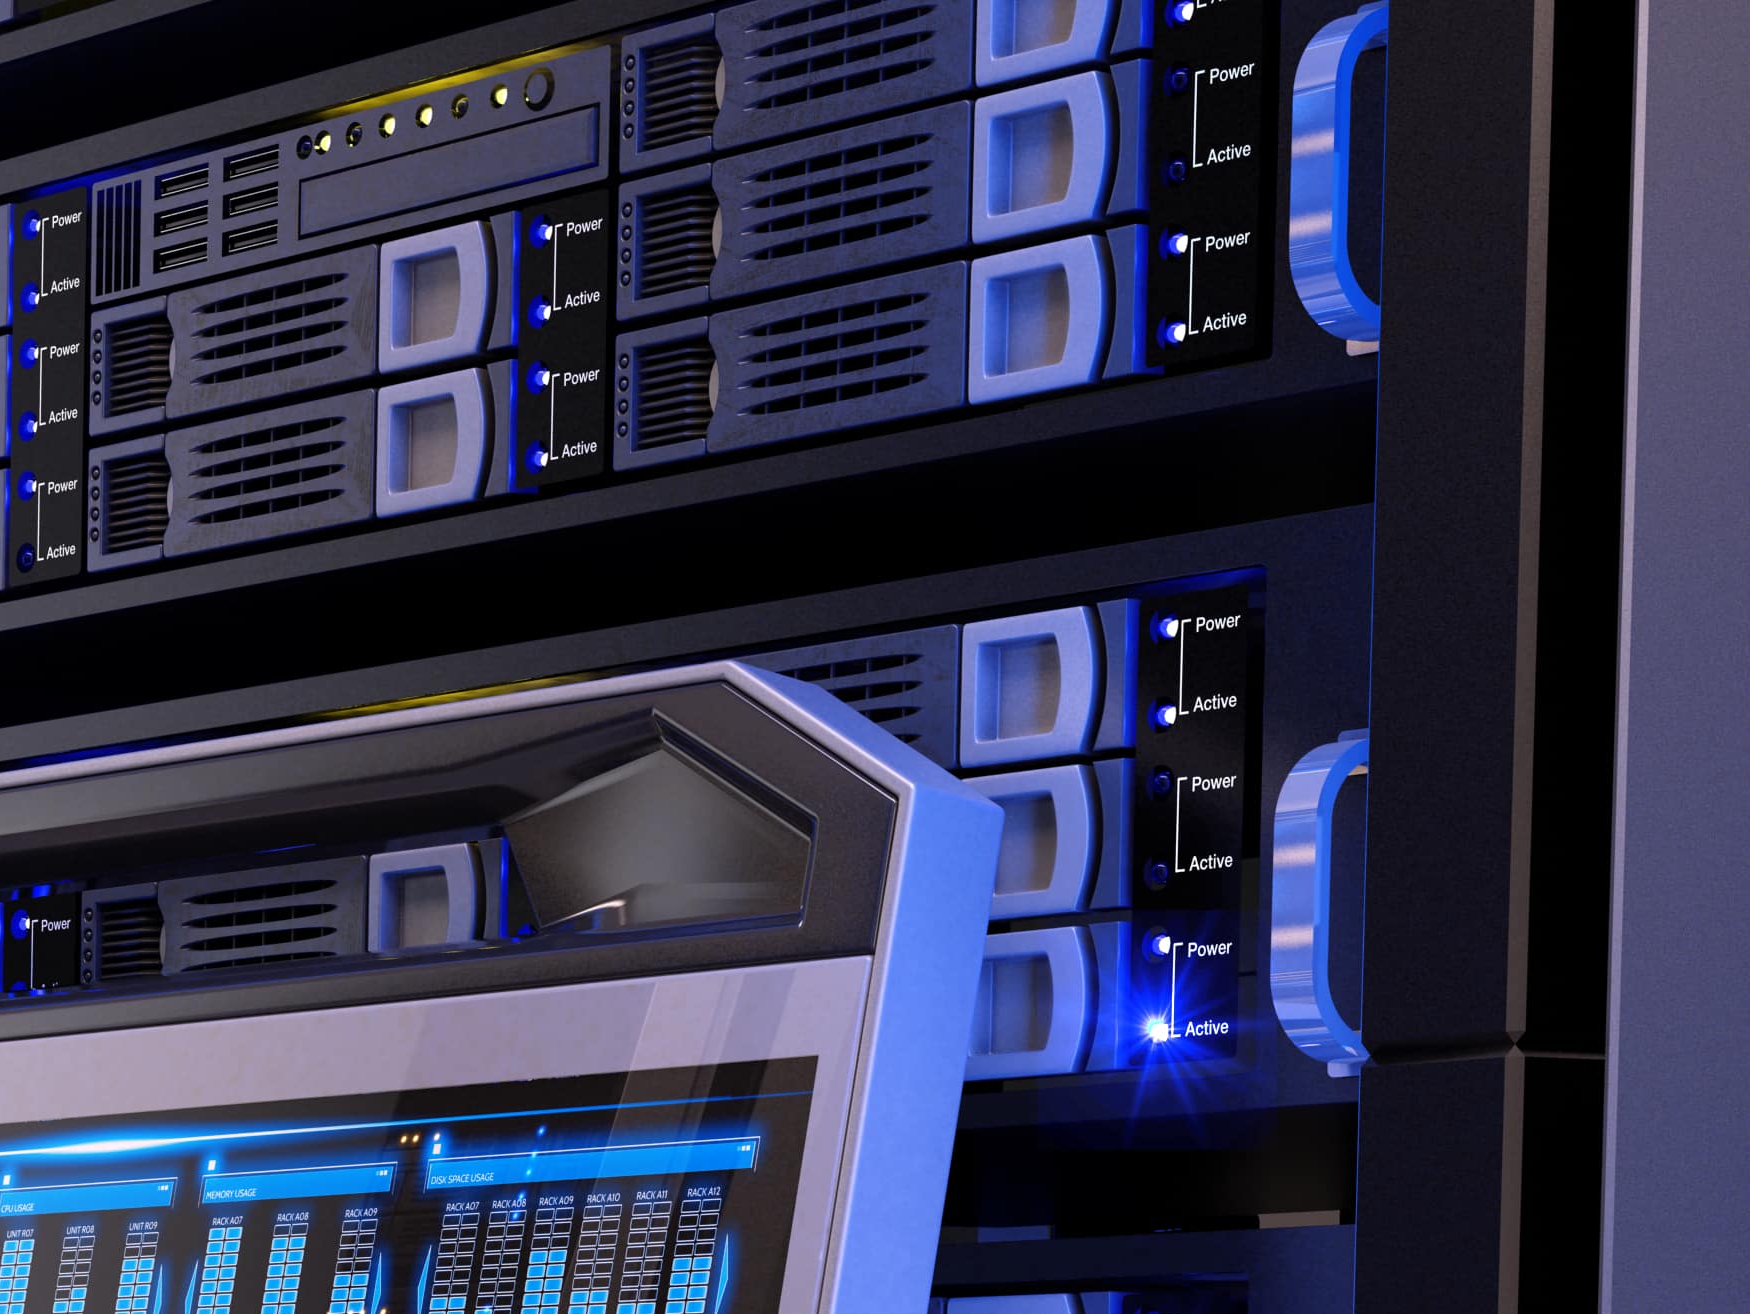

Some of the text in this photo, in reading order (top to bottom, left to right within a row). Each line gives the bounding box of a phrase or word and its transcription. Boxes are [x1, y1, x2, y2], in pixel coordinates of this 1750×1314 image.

[1209, 62, 1255, 85] Power
[1206, 143, 1252, 165] Active
[52, 211, 83, 229] Power
[566, 218, 603, 237] Power
[1205, 231, 1251, 253] Power
[50, 276, 80, 294] Active
[564, 290, 601, 309] Active
[1202, 312, 1247, 333] Active
[49, 342, 80, 360] Power
[563, 369, 600, 387] Power
[48, 407, 78, 425] Active
[561, 440, 598, 459] Active
[47, 479, 78, 495] Power
[46, 543, 76, 560] Active
[1196, 614, 1241, 633] Power
[1192, 693, 1237, 713] Active
[1192, 775, 1237, 793] Power
[1189, 853, 1233, 872] Active
[41, 919, 71, 932] Power
[1187, 941, 1233, 958] Power
[1184, 1019, 1229, 1037] Active
[431, 1171, 494, 1185] DISK SPACE USAGE
[205, 1187, 257, 1200] MEMORY USAGE
[687, 1186, 721, 1197] RACK A12
[1, 1202, 34, 1213] CPU USAGE
[128, 1220, 158, 1232] UNIT R09
[212, 1215, 244, 1226] RACK A07
[6, 1228, 34, 1239] UNIT R07
[66, 1225, 95, 1235] UNIT R08
